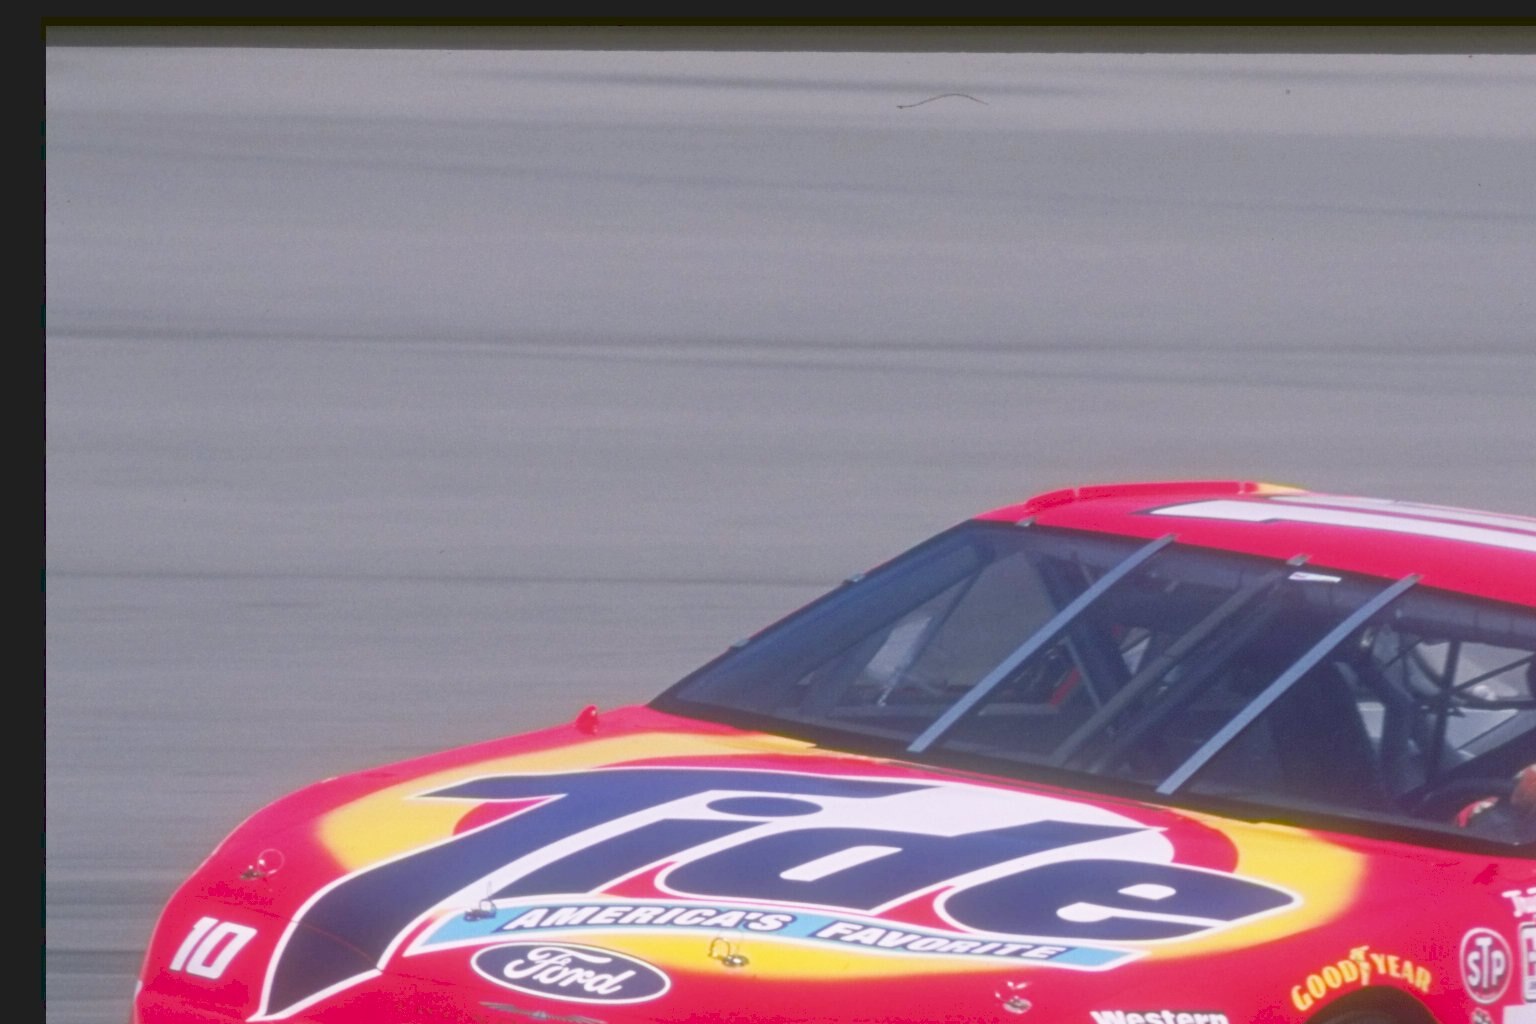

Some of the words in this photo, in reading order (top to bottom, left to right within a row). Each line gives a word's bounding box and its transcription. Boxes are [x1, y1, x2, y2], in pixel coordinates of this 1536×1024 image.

[247, 766, 1303, 1022] Tide
[169, 916, 257, 979] 10
[502, 905, 797, 932] AMERICA'S
[816, 921, 1067, 960] FAVORITE
[1467, 936, 1506, 988] STP
[504, 947, 636, 996] Ford
[1291, 945, 1432, 1011] GOODYEAR
